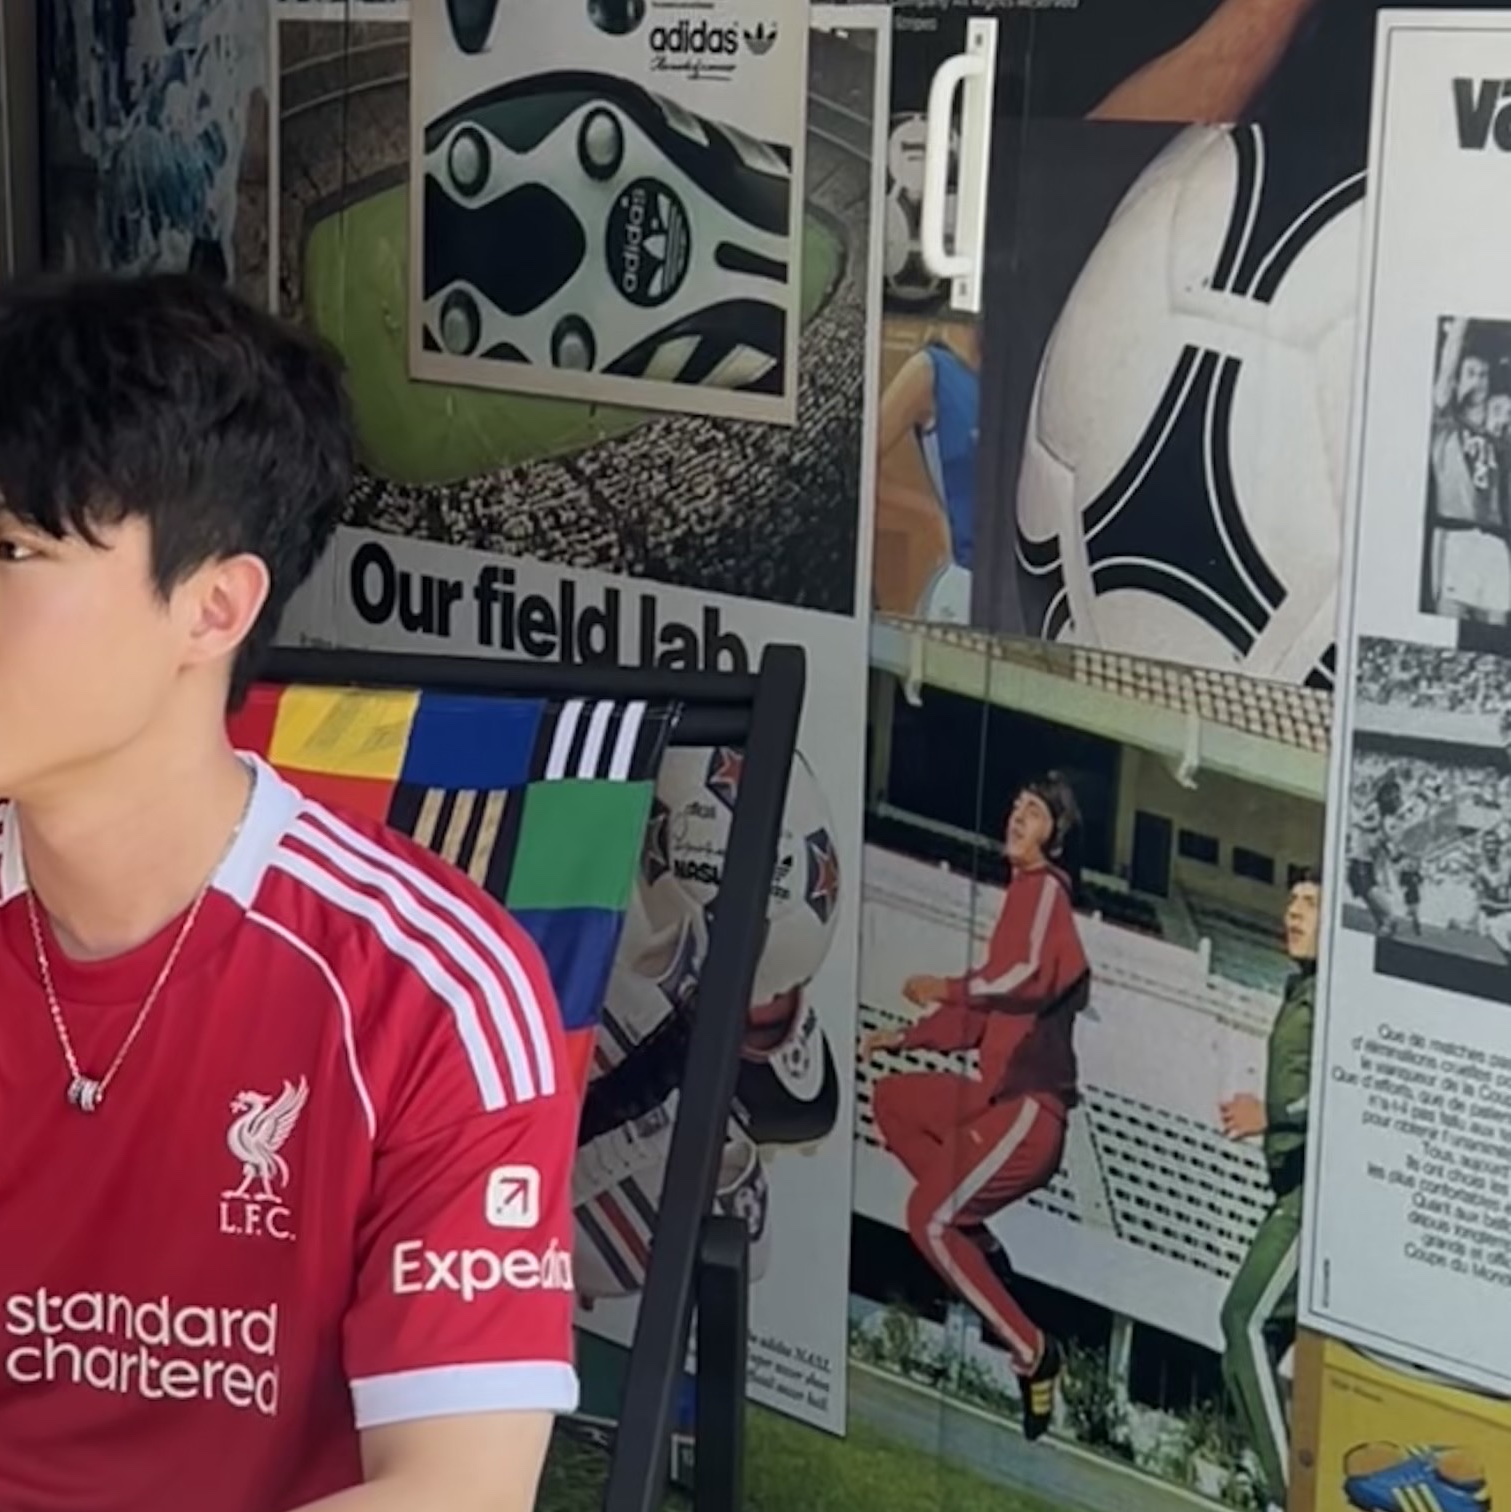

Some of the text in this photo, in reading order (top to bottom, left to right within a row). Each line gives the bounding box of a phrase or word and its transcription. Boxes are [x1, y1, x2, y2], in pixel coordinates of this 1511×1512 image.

[649, 19, 739, 56] adidas
[350, 541, 463, 637] Our
[474, 565, 621, 665] field
[219, 1201, 296, 1241] L.F.C.
[5, 1286, 278, 1356] standard
[6, 1336, 279, 1416] chartered
